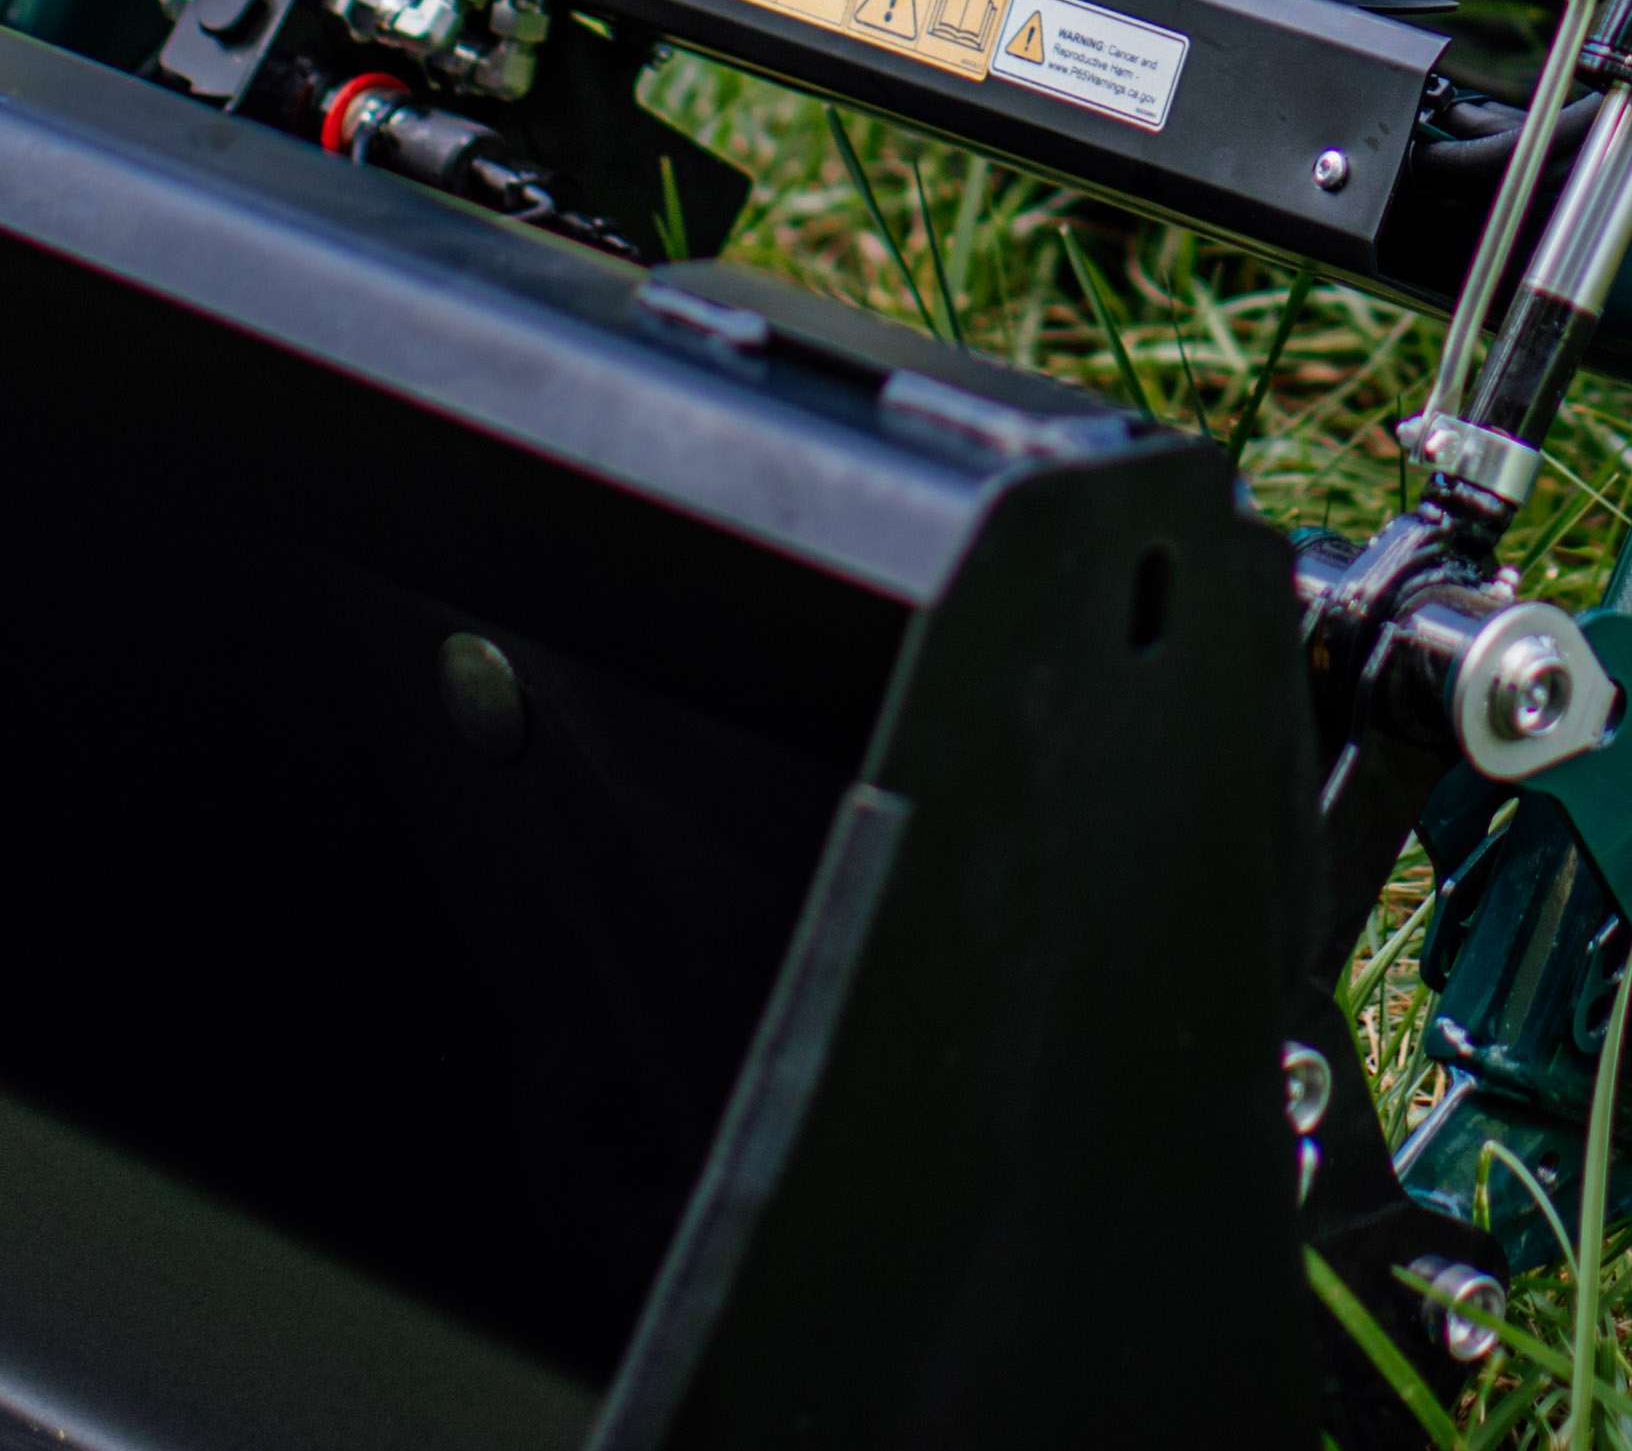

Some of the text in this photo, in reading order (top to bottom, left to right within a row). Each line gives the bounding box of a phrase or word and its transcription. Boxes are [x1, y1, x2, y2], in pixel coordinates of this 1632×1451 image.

[1053, 42, 1109, 71] Reproductive
[1110, 64, 1134, 80] Harm
[1057, 26, 1158, 70] WARNING: Cancer and
[1048, 61, 1156, 104] www.P65Warnings.ca.gov
